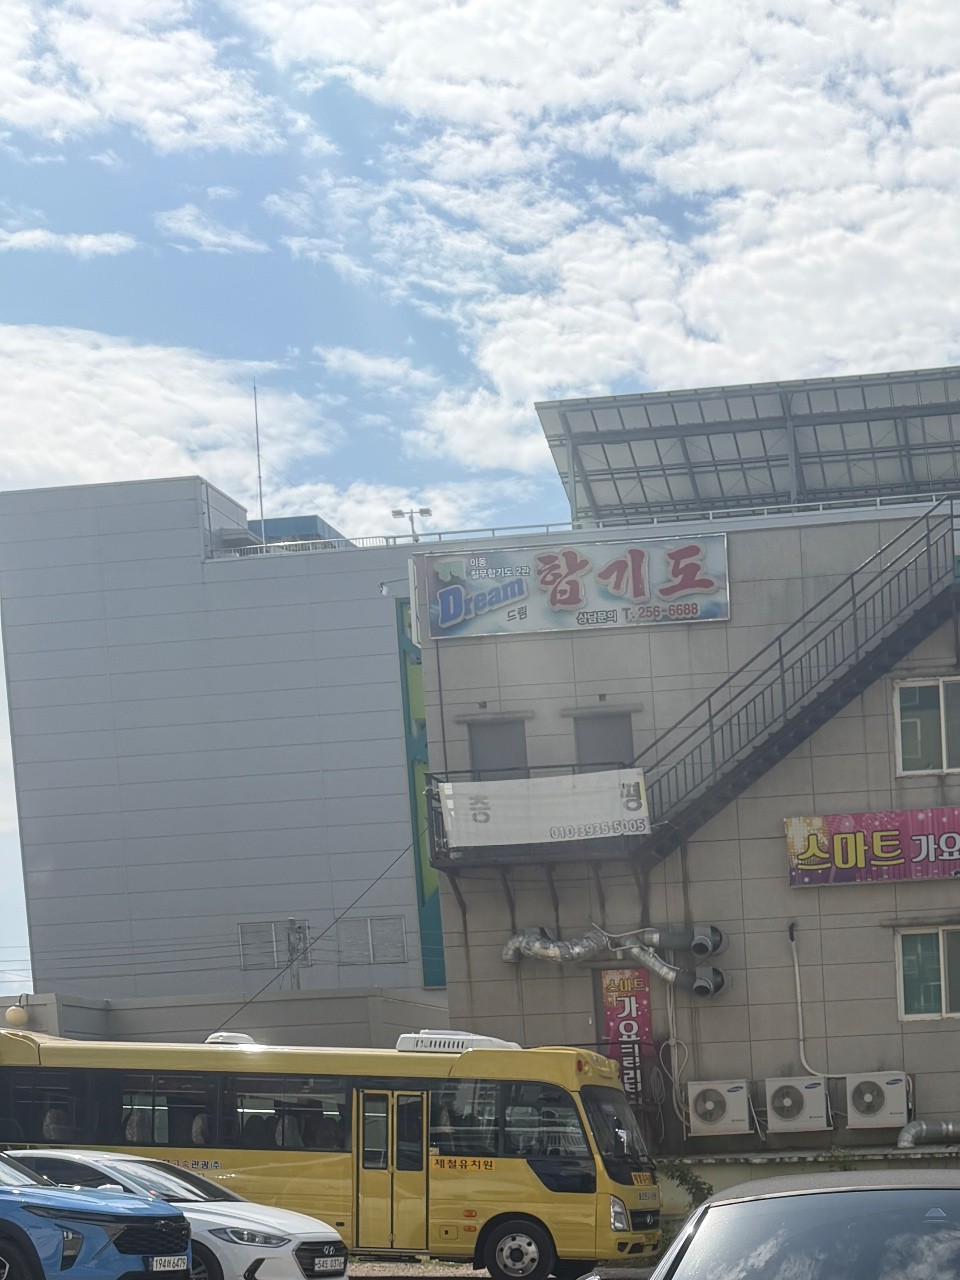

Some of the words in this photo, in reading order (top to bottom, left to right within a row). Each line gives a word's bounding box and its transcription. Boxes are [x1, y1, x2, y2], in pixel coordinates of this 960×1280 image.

[469, 557, 487, 567] 이동
[535, 545, 717, 609] 합기도
[438, 577, 527, 627] Dream
[507, 606, 527, 621] 드림
[576, 610, 618, 624] 상담문의
[797, 830, 905, 870] 스마트
[607, 978, 646, 992] 스마트
